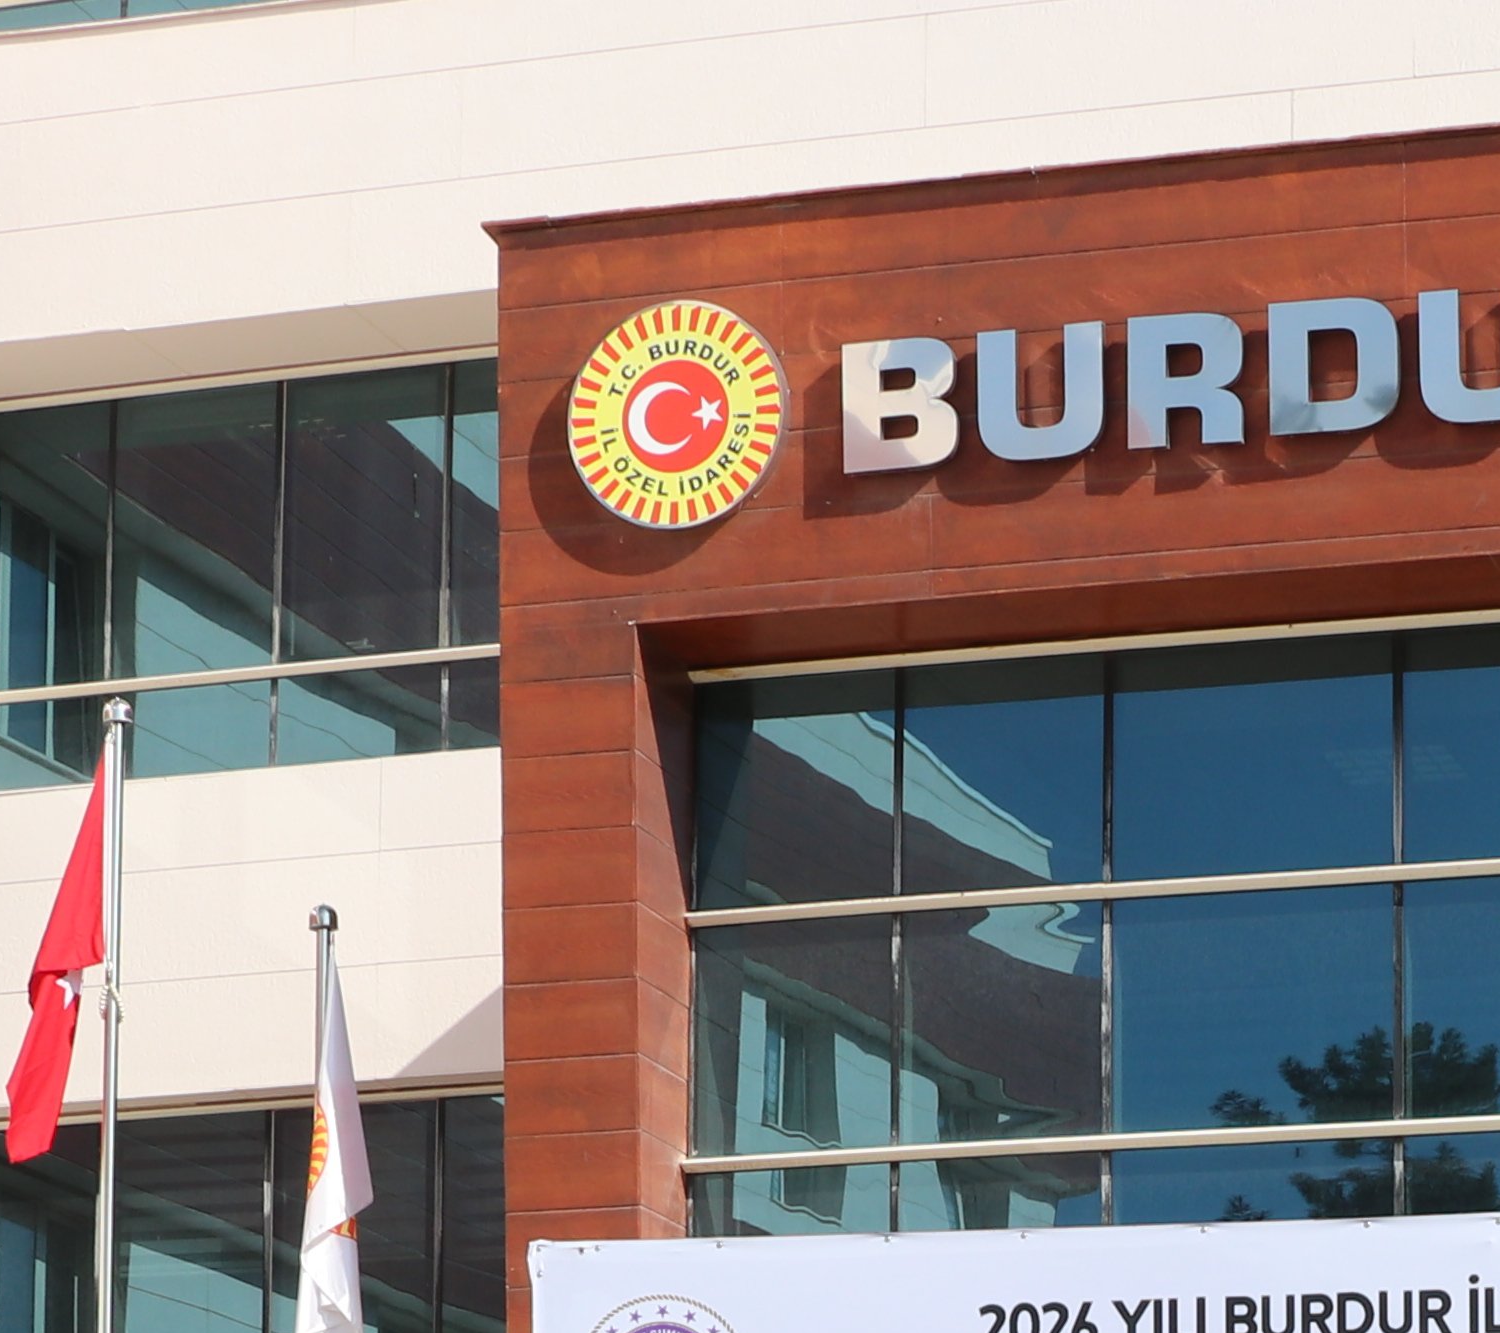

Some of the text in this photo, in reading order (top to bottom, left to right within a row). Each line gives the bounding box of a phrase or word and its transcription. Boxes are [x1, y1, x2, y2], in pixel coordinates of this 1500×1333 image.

[608, 339, 740, 398] T.C. BURDUR
[601, 412, 752, 496] İL ÖZEL İDARESİ
